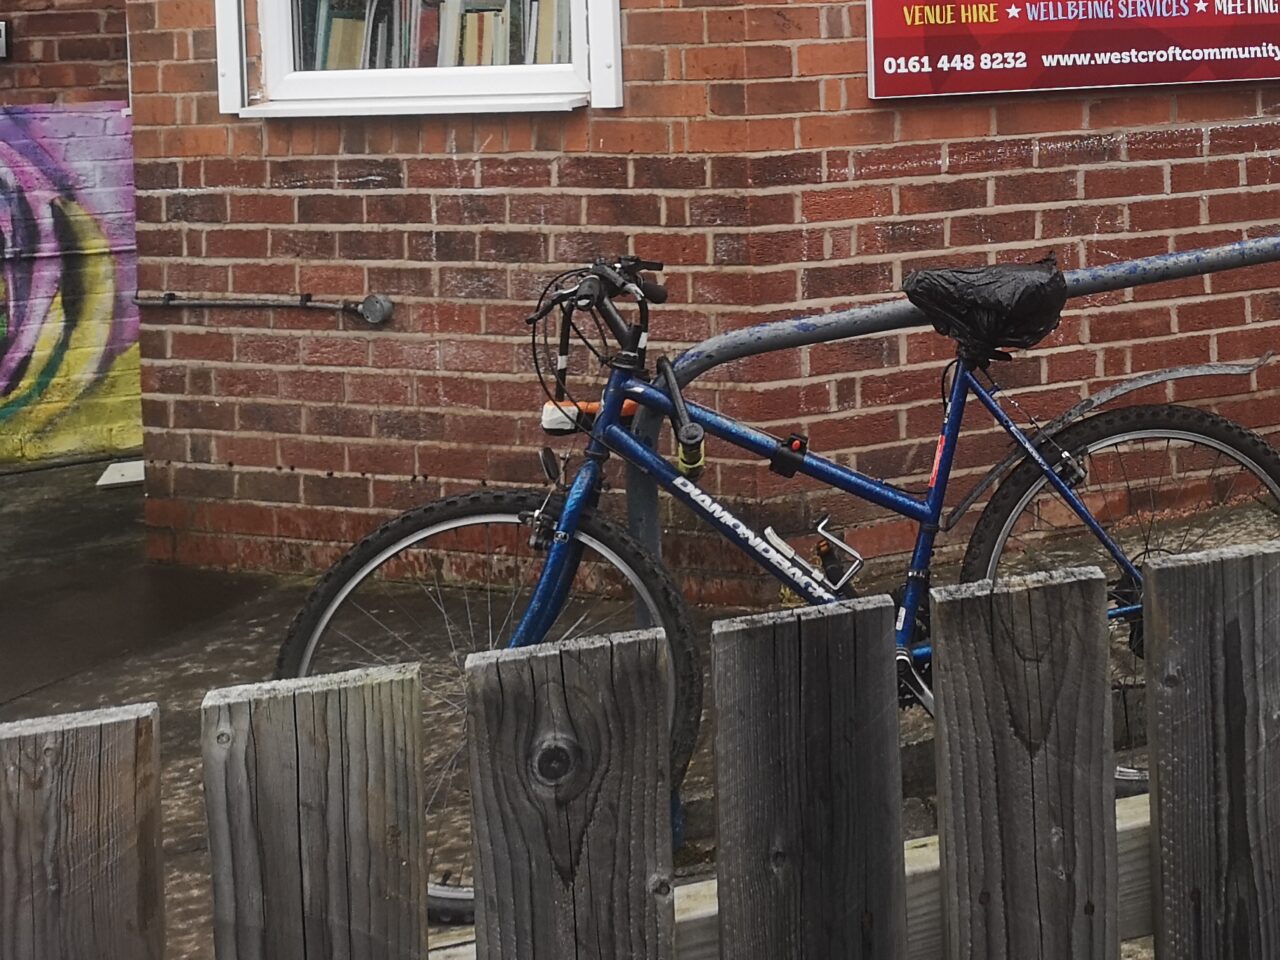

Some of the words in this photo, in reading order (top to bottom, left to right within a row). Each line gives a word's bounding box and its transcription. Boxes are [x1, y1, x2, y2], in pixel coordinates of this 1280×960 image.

[902, 3, 957, 26] VENUE
[960, 2, 1000, 24] HIRE
[883, 55, 932, 75] 0161
[936, 54, 975, 72] 448
[979, 51, 1028, 71] 8232
[672, 476, 838, 604] DIAMONDBACK
